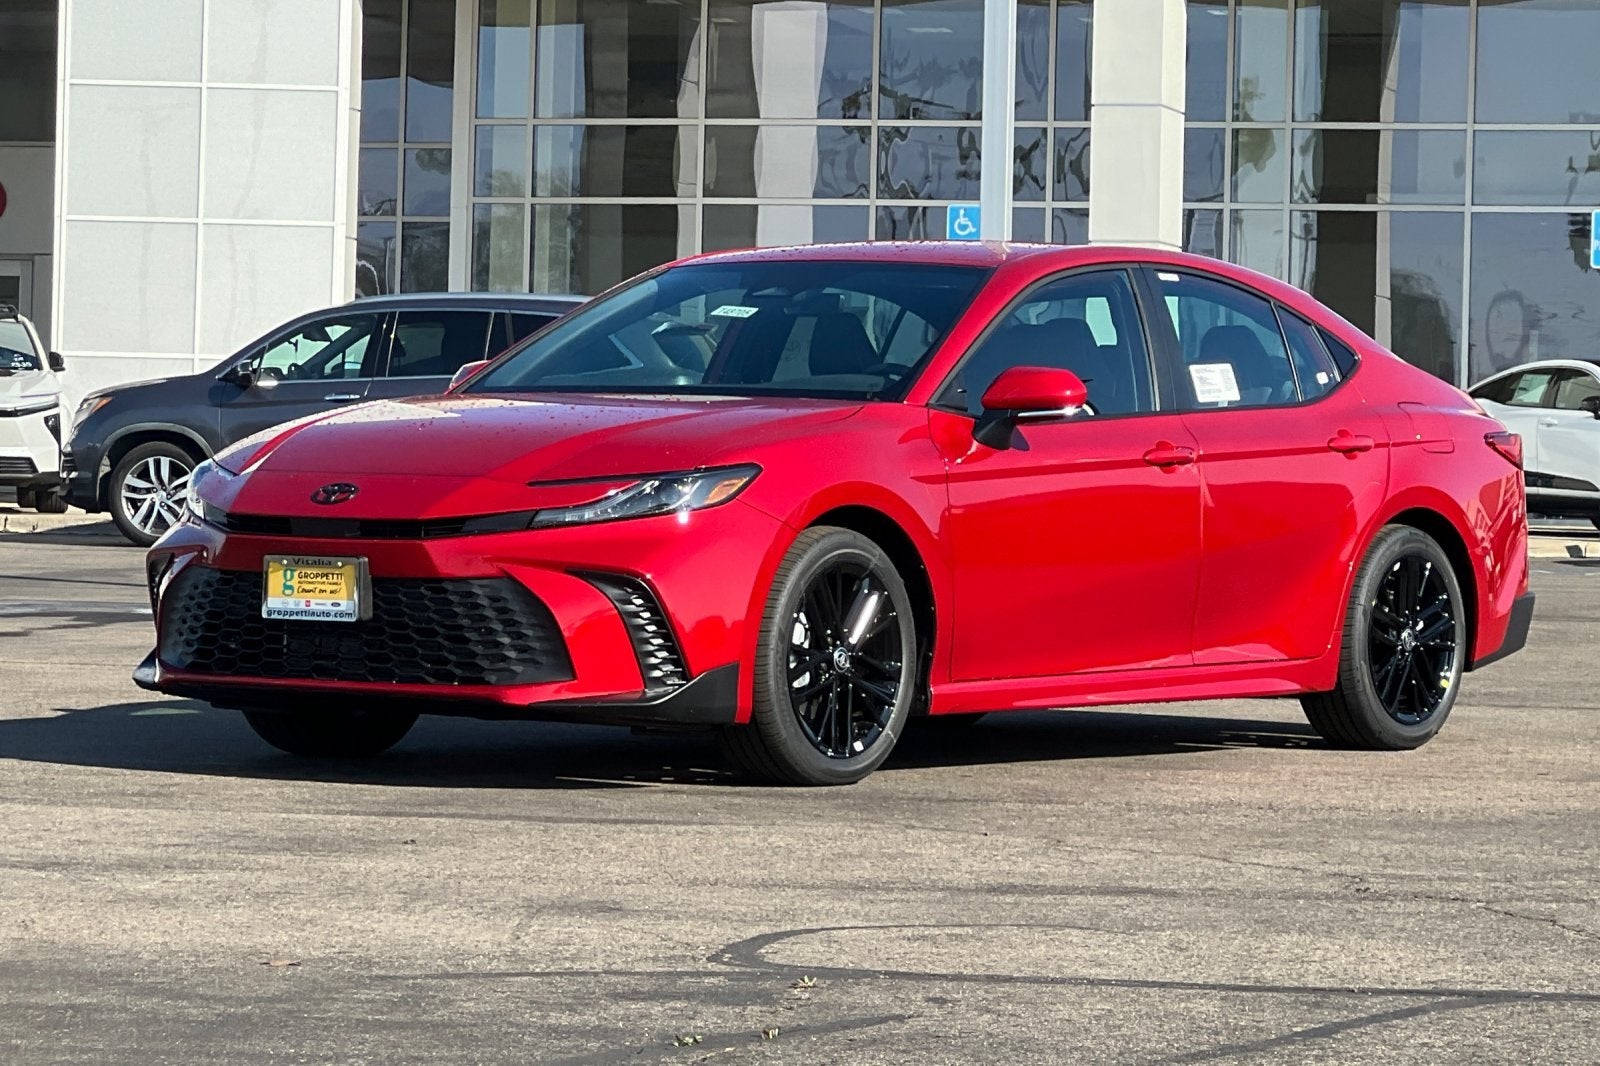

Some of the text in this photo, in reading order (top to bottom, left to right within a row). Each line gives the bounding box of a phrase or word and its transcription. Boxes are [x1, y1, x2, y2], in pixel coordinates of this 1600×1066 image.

[297, 571, 343, 581] GROPPETTI
[283, 568, 297, 596] g
[297, 586, 317, 594] Count
[266, 609, 353, 619] groppettiauto.com
